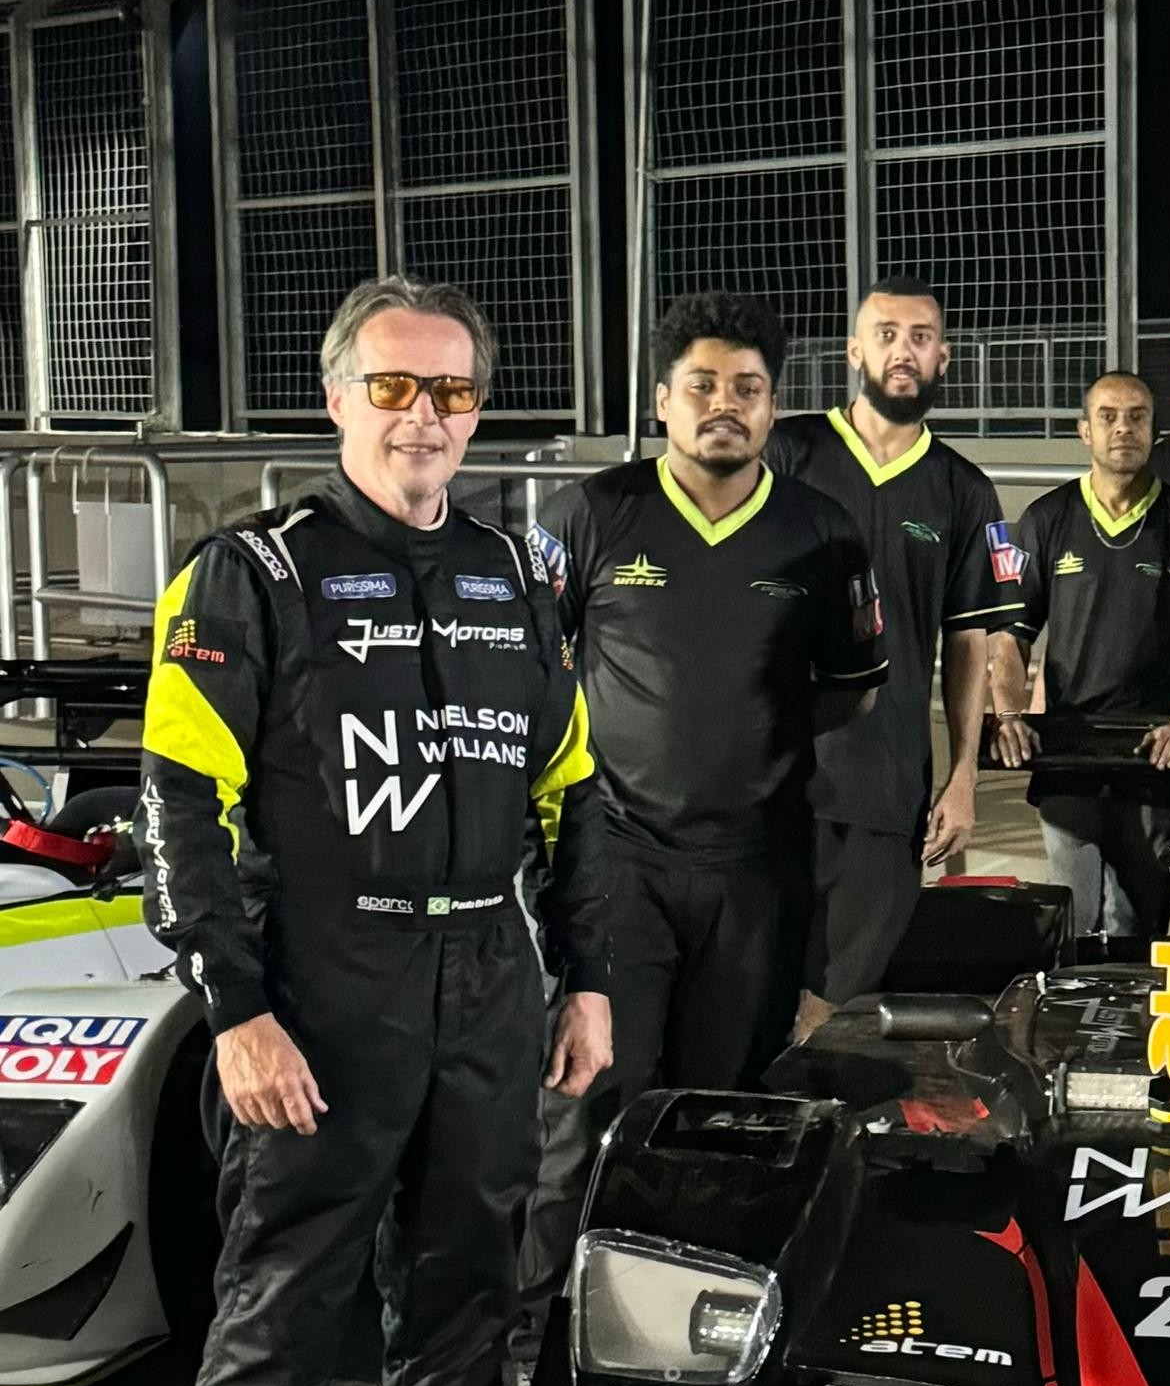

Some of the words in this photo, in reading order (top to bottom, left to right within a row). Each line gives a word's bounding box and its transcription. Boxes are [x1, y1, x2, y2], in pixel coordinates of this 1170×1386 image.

[235, 529, 289, 582] sparco
[169, 644, 226, 664] atem
[415, 704, 530, 736] NELSON
[417, 736, 527, 769] WILIANS
[0, 1017, 139, 1046] IQUI
[0, 1047, 125, 1082] OLY
[859, 1336, 1013, 1367] atem
